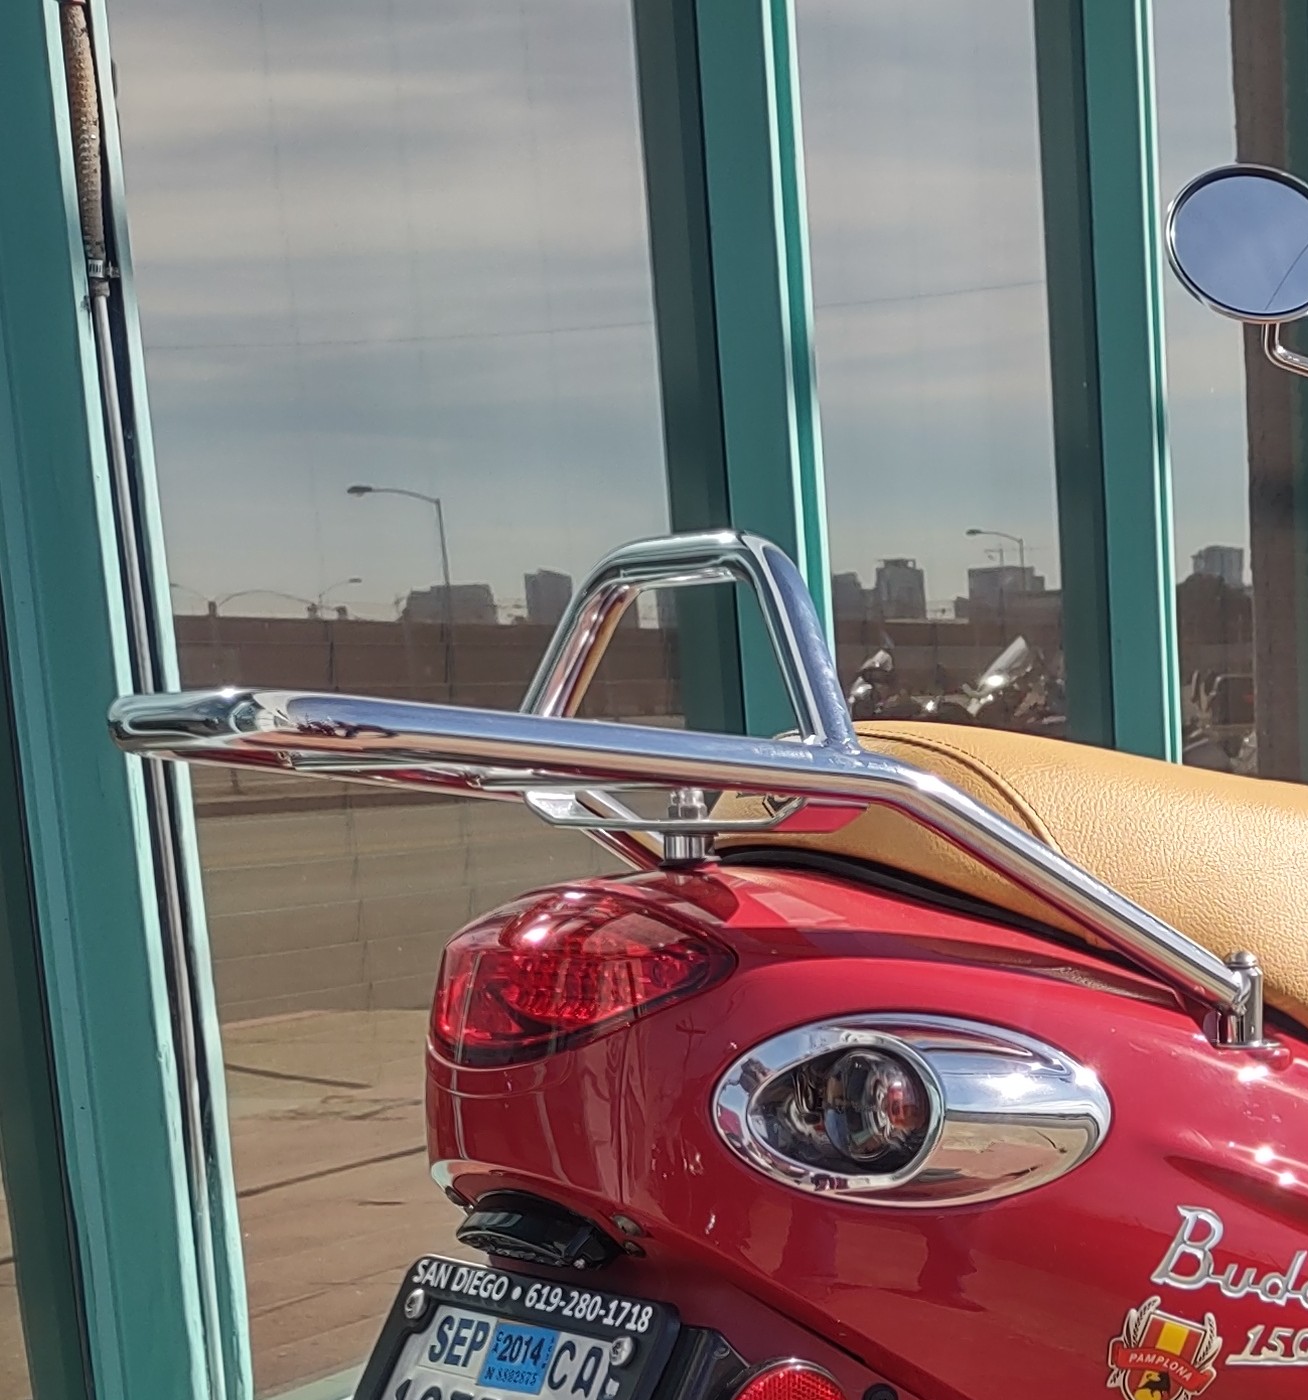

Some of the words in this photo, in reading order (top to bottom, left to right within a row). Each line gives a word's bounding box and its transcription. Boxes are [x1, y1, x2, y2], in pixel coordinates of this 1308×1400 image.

[412, 1259, 452, 1290] SAN
[451, 1266, 509, 1300] DIEGO
[524, 1283, 653, 1333] 619-280-1718
[428, 1315, 491, 1368] SEP
[496, 1334, 545, 1366] 2014
[1128, 1352, 1192, 1382] PAMPLONA
